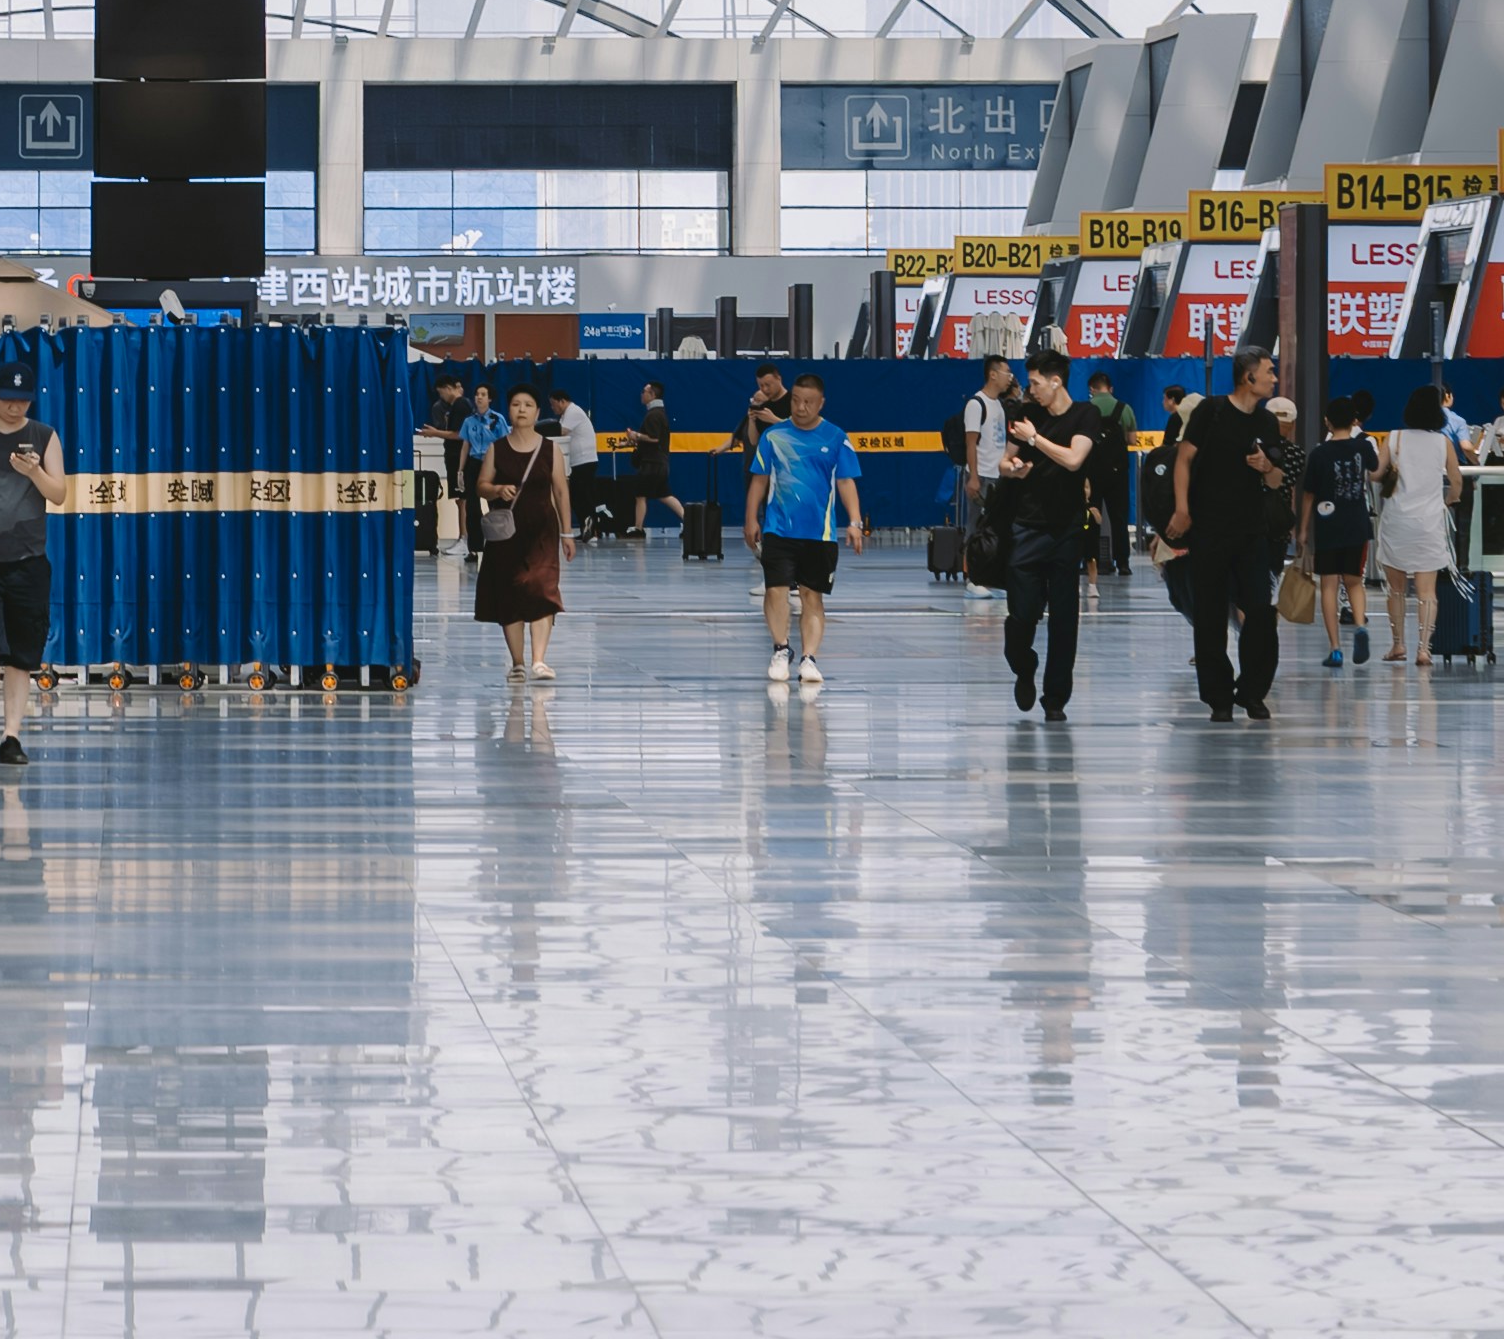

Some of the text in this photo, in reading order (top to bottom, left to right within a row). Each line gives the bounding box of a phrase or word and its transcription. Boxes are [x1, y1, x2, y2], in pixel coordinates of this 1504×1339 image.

[931, 143, 995, 160] North
[1337, 172, 1453, 210] B14-B15
[1089, 219, 1182, 249] B18-B19
[962, 242, 1042, 268] B20-B21
[857, 436, 906, 449] 安检区域
